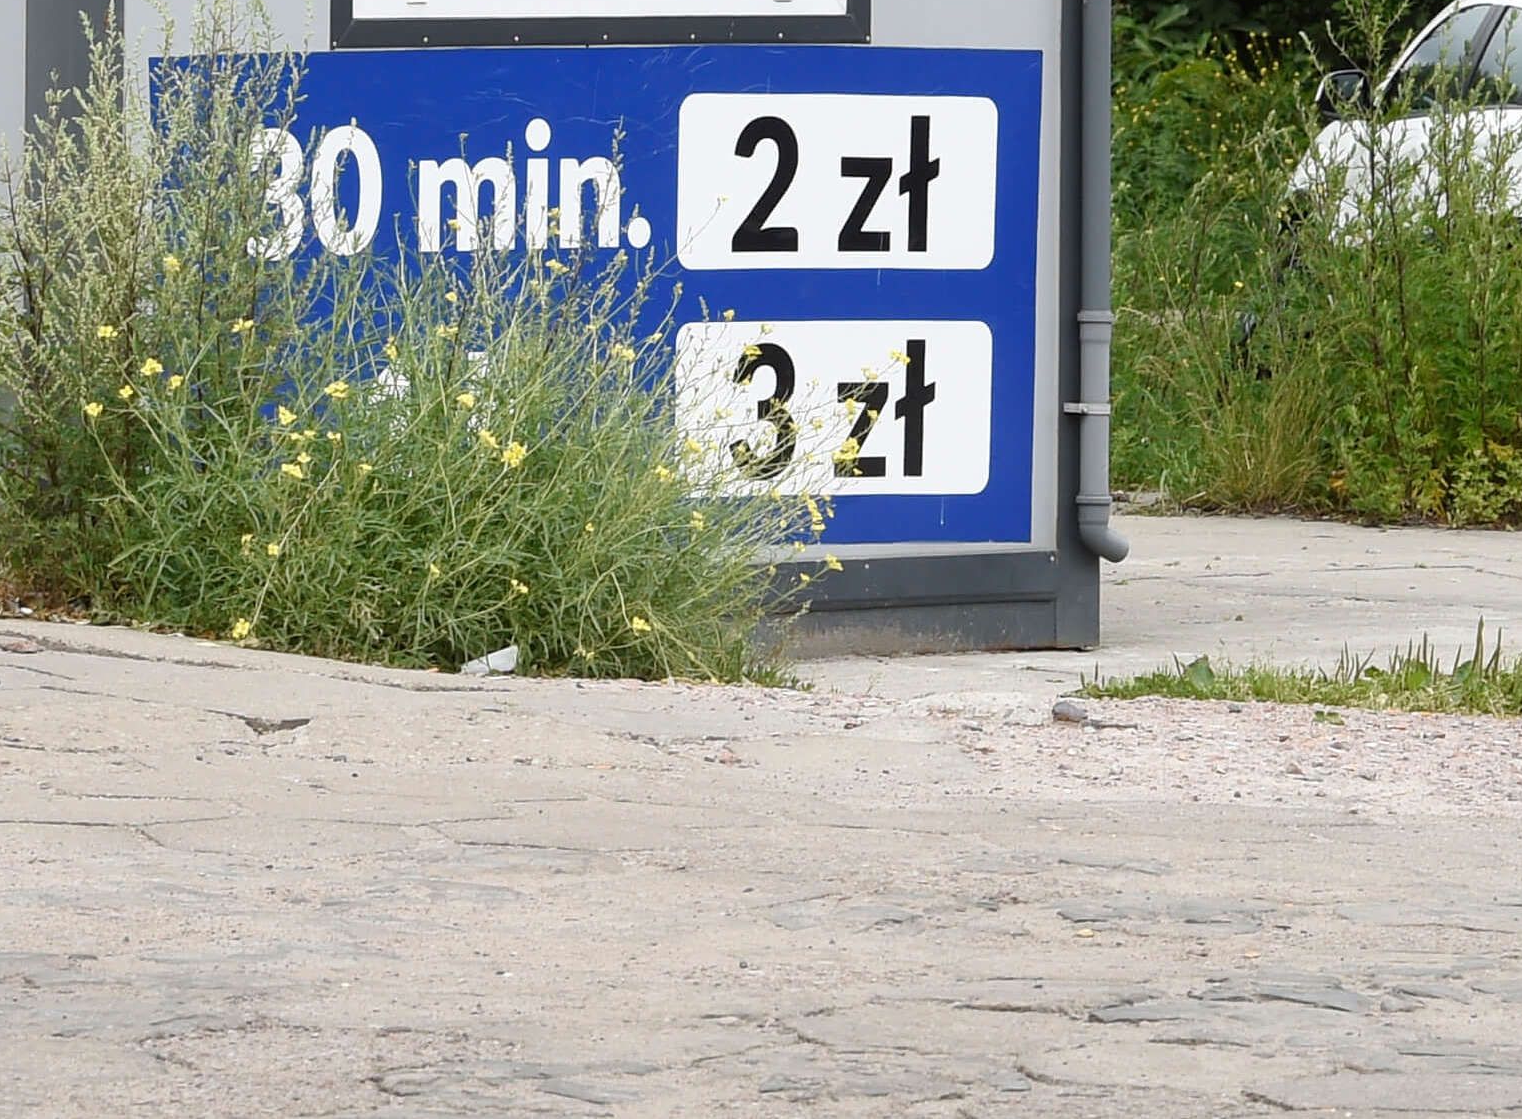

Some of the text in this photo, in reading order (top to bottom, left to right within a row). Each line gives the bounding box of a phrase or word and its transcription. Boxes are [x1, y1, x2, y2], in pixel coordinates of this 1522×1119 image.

[247, 115, 940, 262] 30 min. 2 zł
[730, 339, 936, 481] 3 zł
